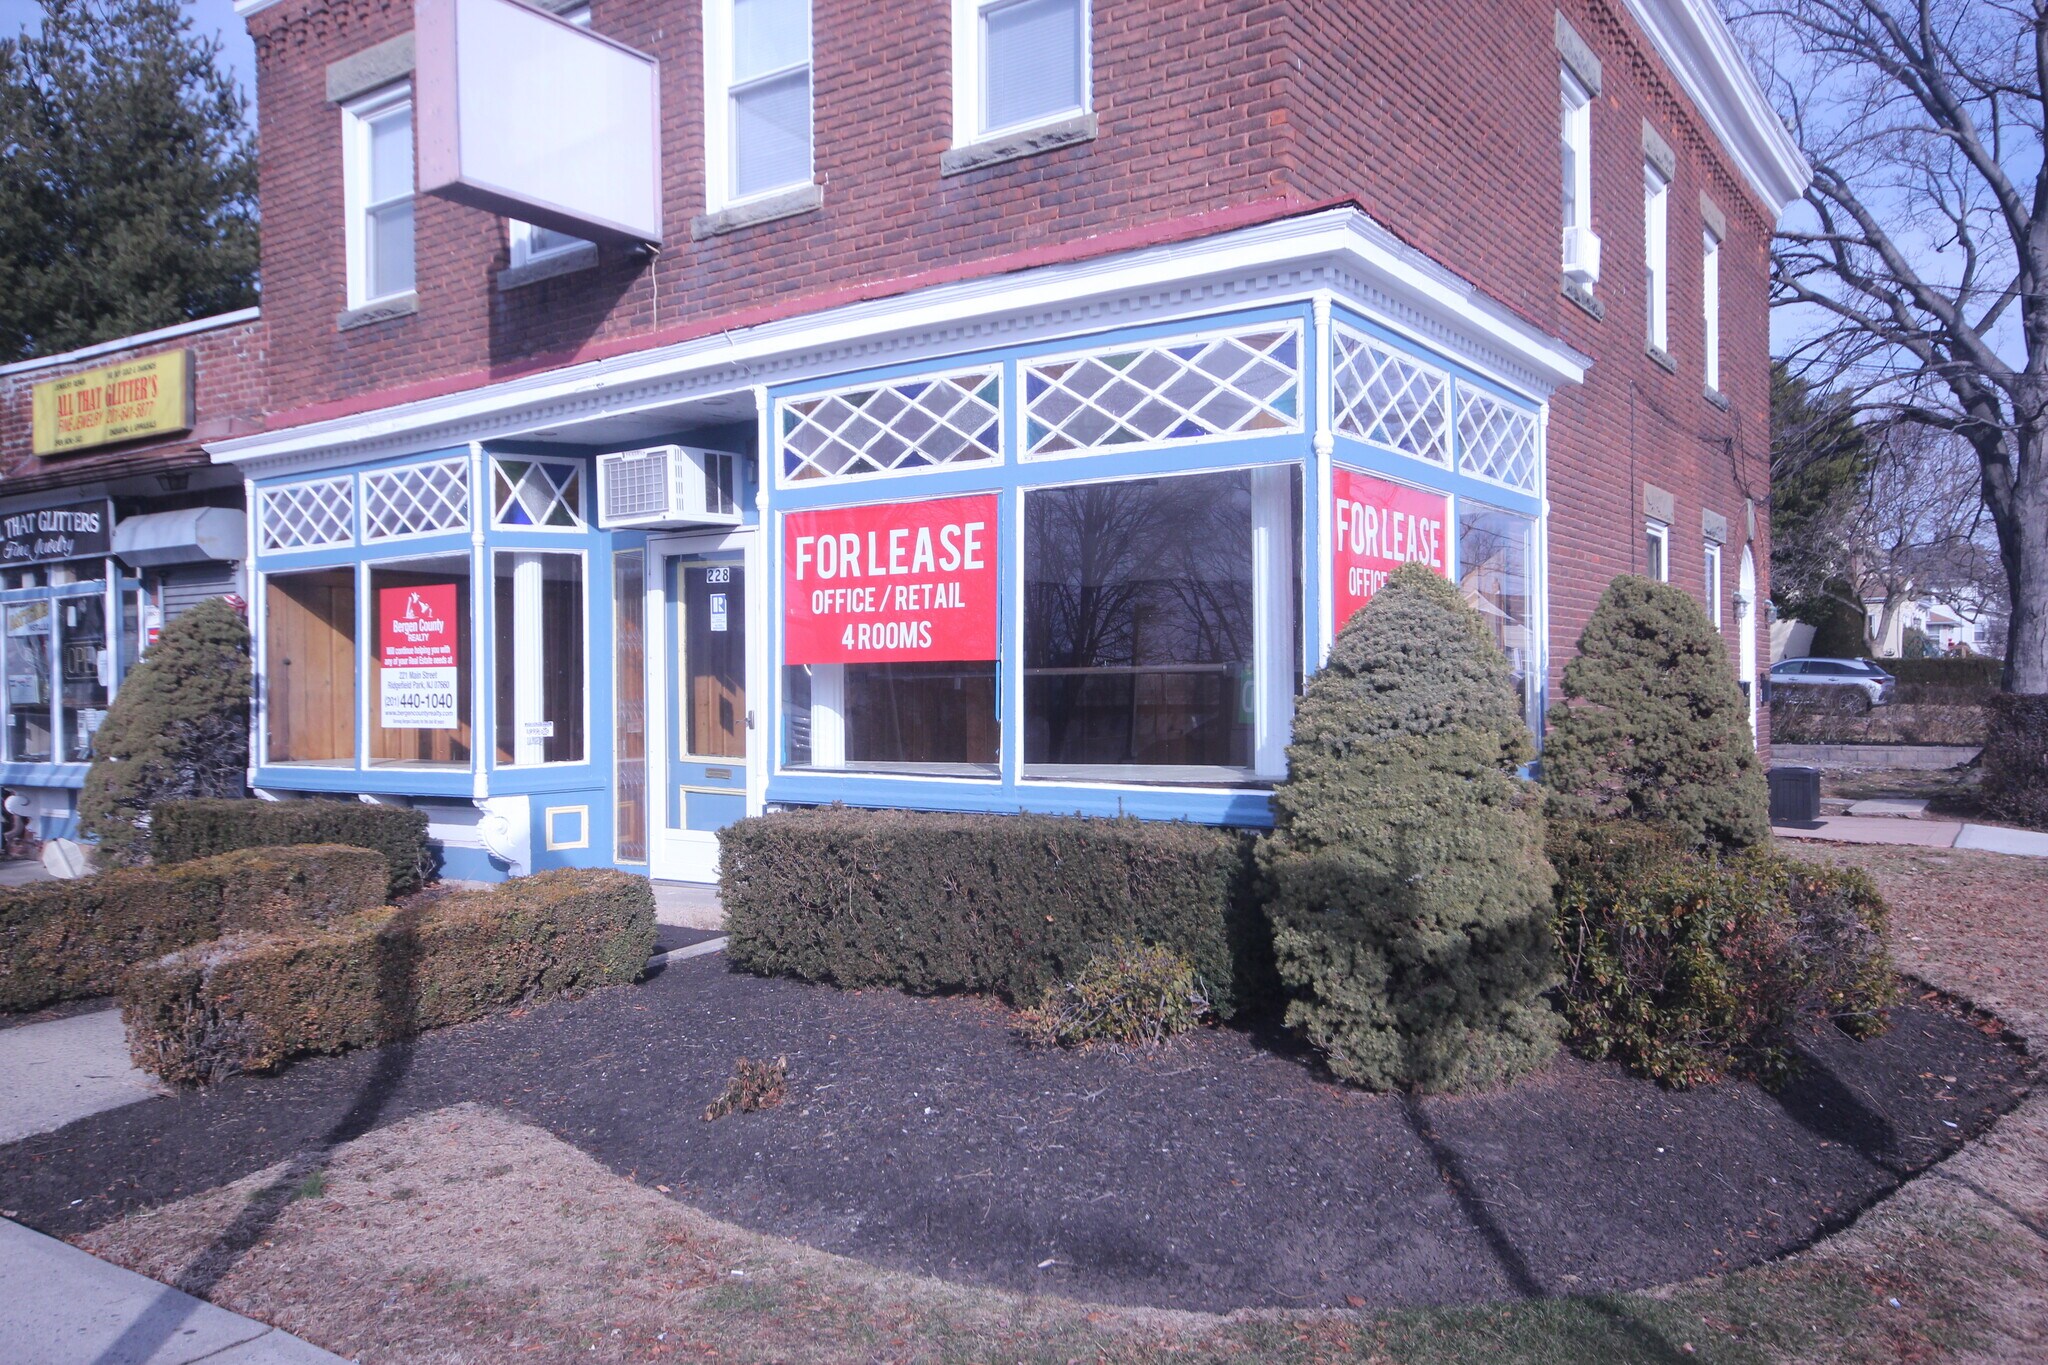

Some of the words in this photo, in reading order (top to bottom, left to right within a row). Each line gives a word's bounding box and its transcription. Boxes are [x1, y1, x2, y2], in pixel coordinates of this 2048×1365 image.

[57, 393, 74, 417] ALL
[77, 386, 102, 413] THAT
[105, 374, 158, 407] GLITTER'S
[58, 417, 73, 433] FINE
[73, 412, 103, 430] JEWELRY
[4, 512, 36, 539] THAT
[38, 510, 100, 533] GLITTERS
[1336, 498, 1379, 557] FOR
[1382, 508, 1441, 568] LEASE
[3, 541, 30, 559] Fine
[29, 534, 74, 561] Jewelry
[796, 532, 861, 581] FOR
[868, 521, 985, 577] LEASE
[708, 568, 729, 582] 228
[811, 586, 876, 615] OFFICE
[895, 582, 966, 611] RETAIL
[393, 619, 418, 635] Bergen
[418, 618, 444, 634] County
[407, 633, 430, 641] REALTY
[841, 624, 855, 650] 4
[858, 620, 932, 649] ROOMS
[67, 646, 97, 674] OPE
[387, 681, 412, 690] Ridgefield
[409, 671, 421, 679] Main
[422, 671, 438, 679] Street
[400, 693, 453, 708] 440-1040
